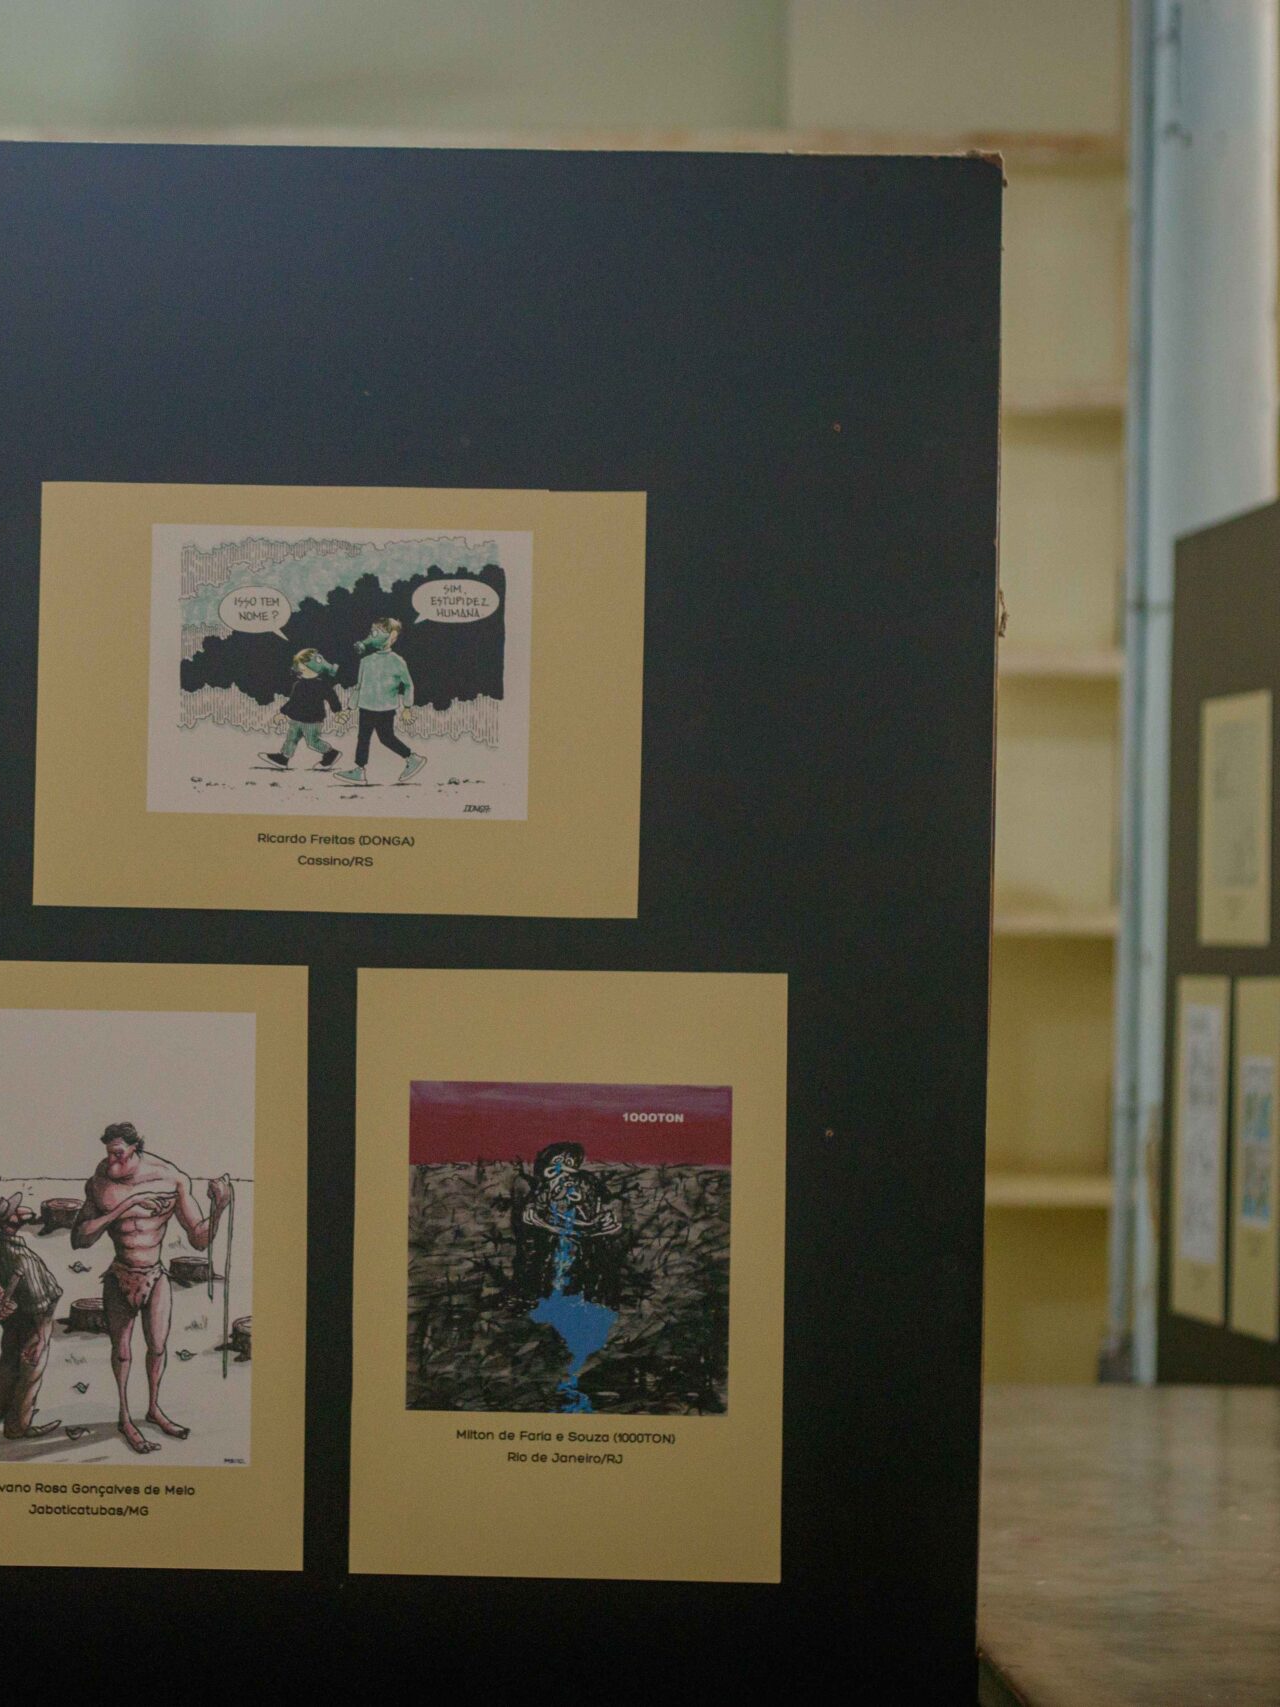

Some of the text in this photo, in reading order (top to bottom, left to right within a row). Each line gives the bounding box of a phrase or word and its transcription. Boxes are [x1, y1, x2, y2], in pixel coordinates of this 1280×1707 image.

[261, 596, 280, 607] TEM
[430, 595, 489, 607] ESTUPIDEZ
[257, 833, 415, 848] Ricardo Freitas (DONGA)
[297, 855, 374, 868] Cassino/RS
[622, 1112, 685, 1123] 1000TON
[456, 1429, 676, 1445] Milton de Faria e Souza (1000TON)
[507, 1451, 623, 1465] Rio de Janeiro/RJ
[35, 1483, 68, 1494] Rosa
[71, 1483, 141, 1498] Gonçalves
[144, 1484, 161, 1495] de
[164, 1485, 196, 1496] Melo
[28, 1503, 149, 1517] Jaboticatubas/MG
